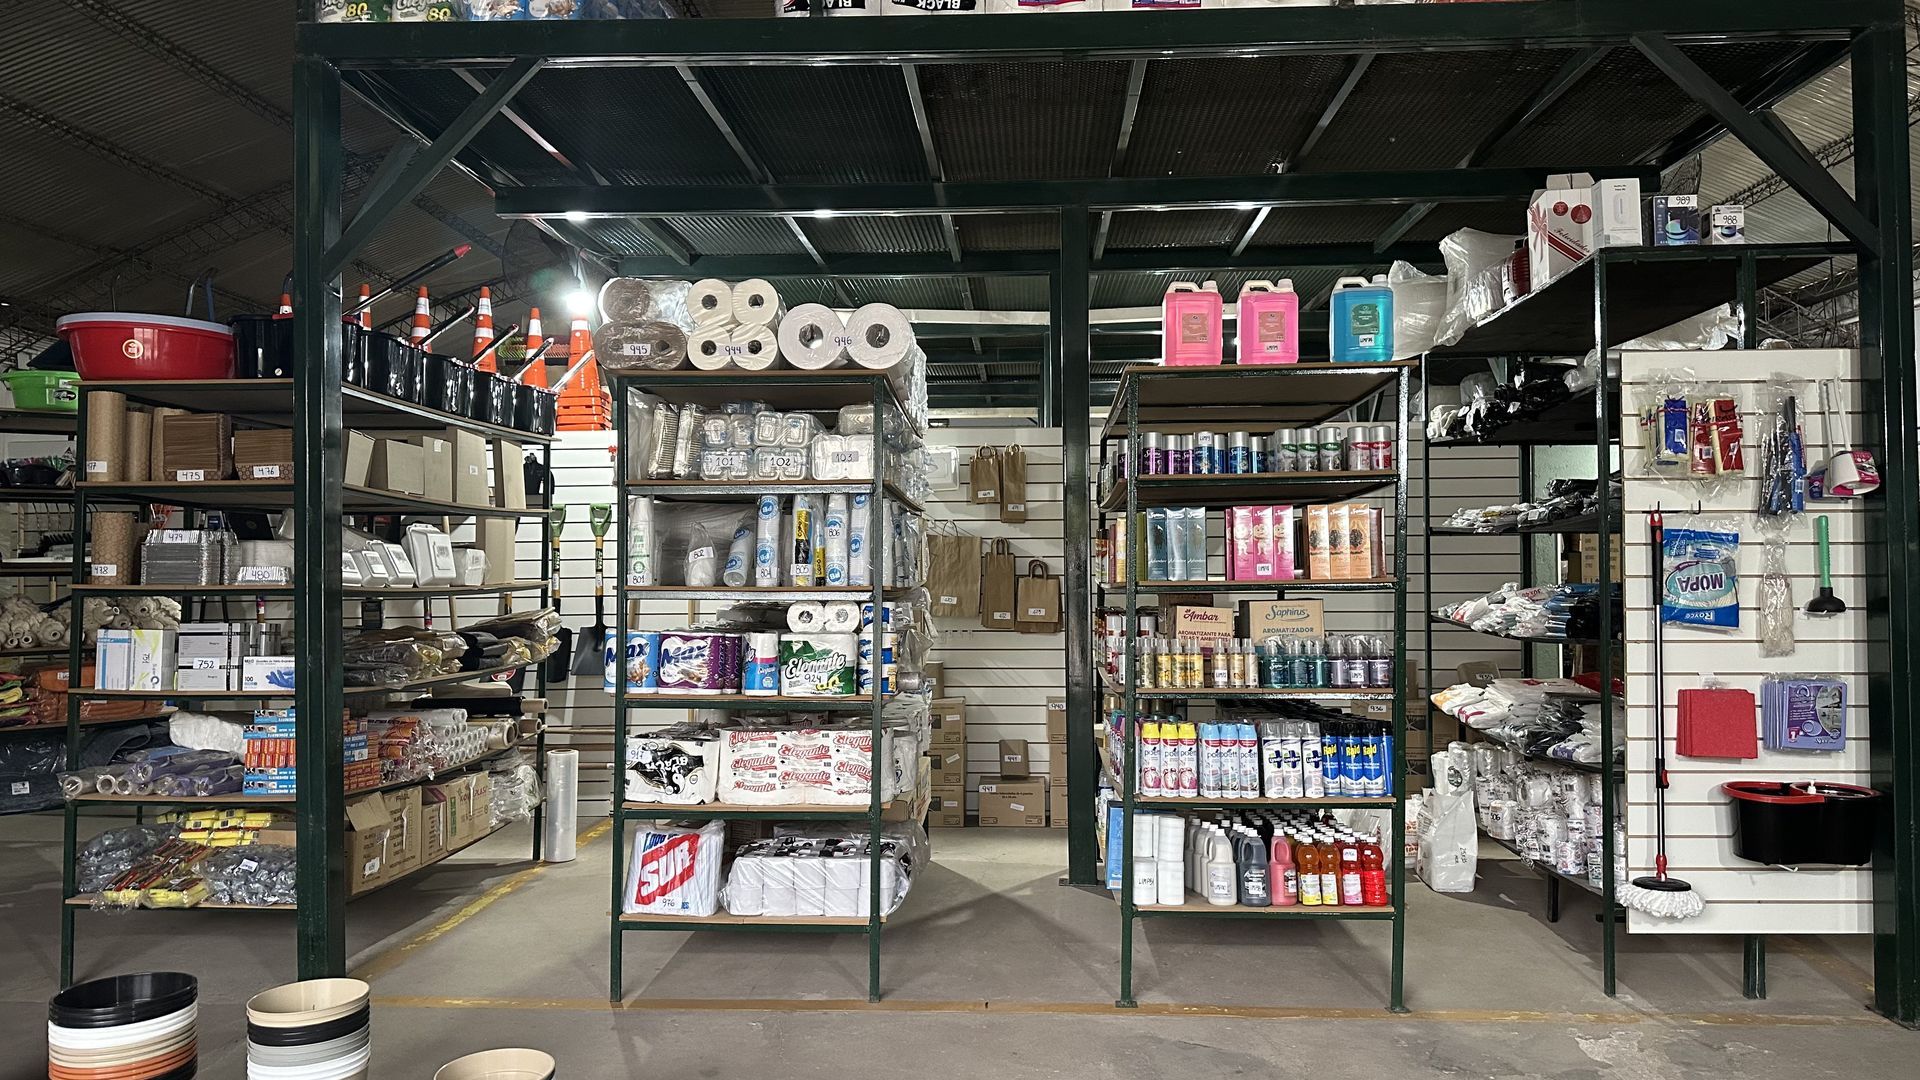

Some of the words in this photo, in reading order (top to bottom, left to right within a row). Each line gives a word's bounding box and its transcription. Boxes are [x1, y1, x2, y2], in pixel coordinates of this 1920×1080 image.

[1675, 196, 1691, 206] 989
[1722, 215, 1738, 225] 988
[834, 336, 853, 348] 946
[629, 344, 648, 355] 945
[724, 345, 742, 356] 944
[715, 457, 735, 467] 101
[770, 457, 792, 467] 102
[835, 453, 853, 463] 103
[182, 472, 201, 481] 475
[258, 468, 275, 476] 476
[168, 532, 184, 542] 479
[828, 528, 841, 538] 806
[94, 565, 109, 576] 478
[251, 570, 271, 580] 480
[632, 574, 646, 584] 801
[1676, 572, 1725, 595] MOPA
[1183, 610, 1219, 622] Ambar
[1264, 604, 1308, 621] Saphirus
[197, 658, 215, 670] 752
[804, 674, 822, 684] 924
[779, 744, 830, 760] Elegante
[1324, 744, 1338, 755] Raid
[1346, 745, 1361, 756] Raid
[731, 756, 776, 772] Elegante
[779, 771, 831, 786] Elegante
[639, 840, 695, 898] SUR
[662, 898, 676, 908] 976
